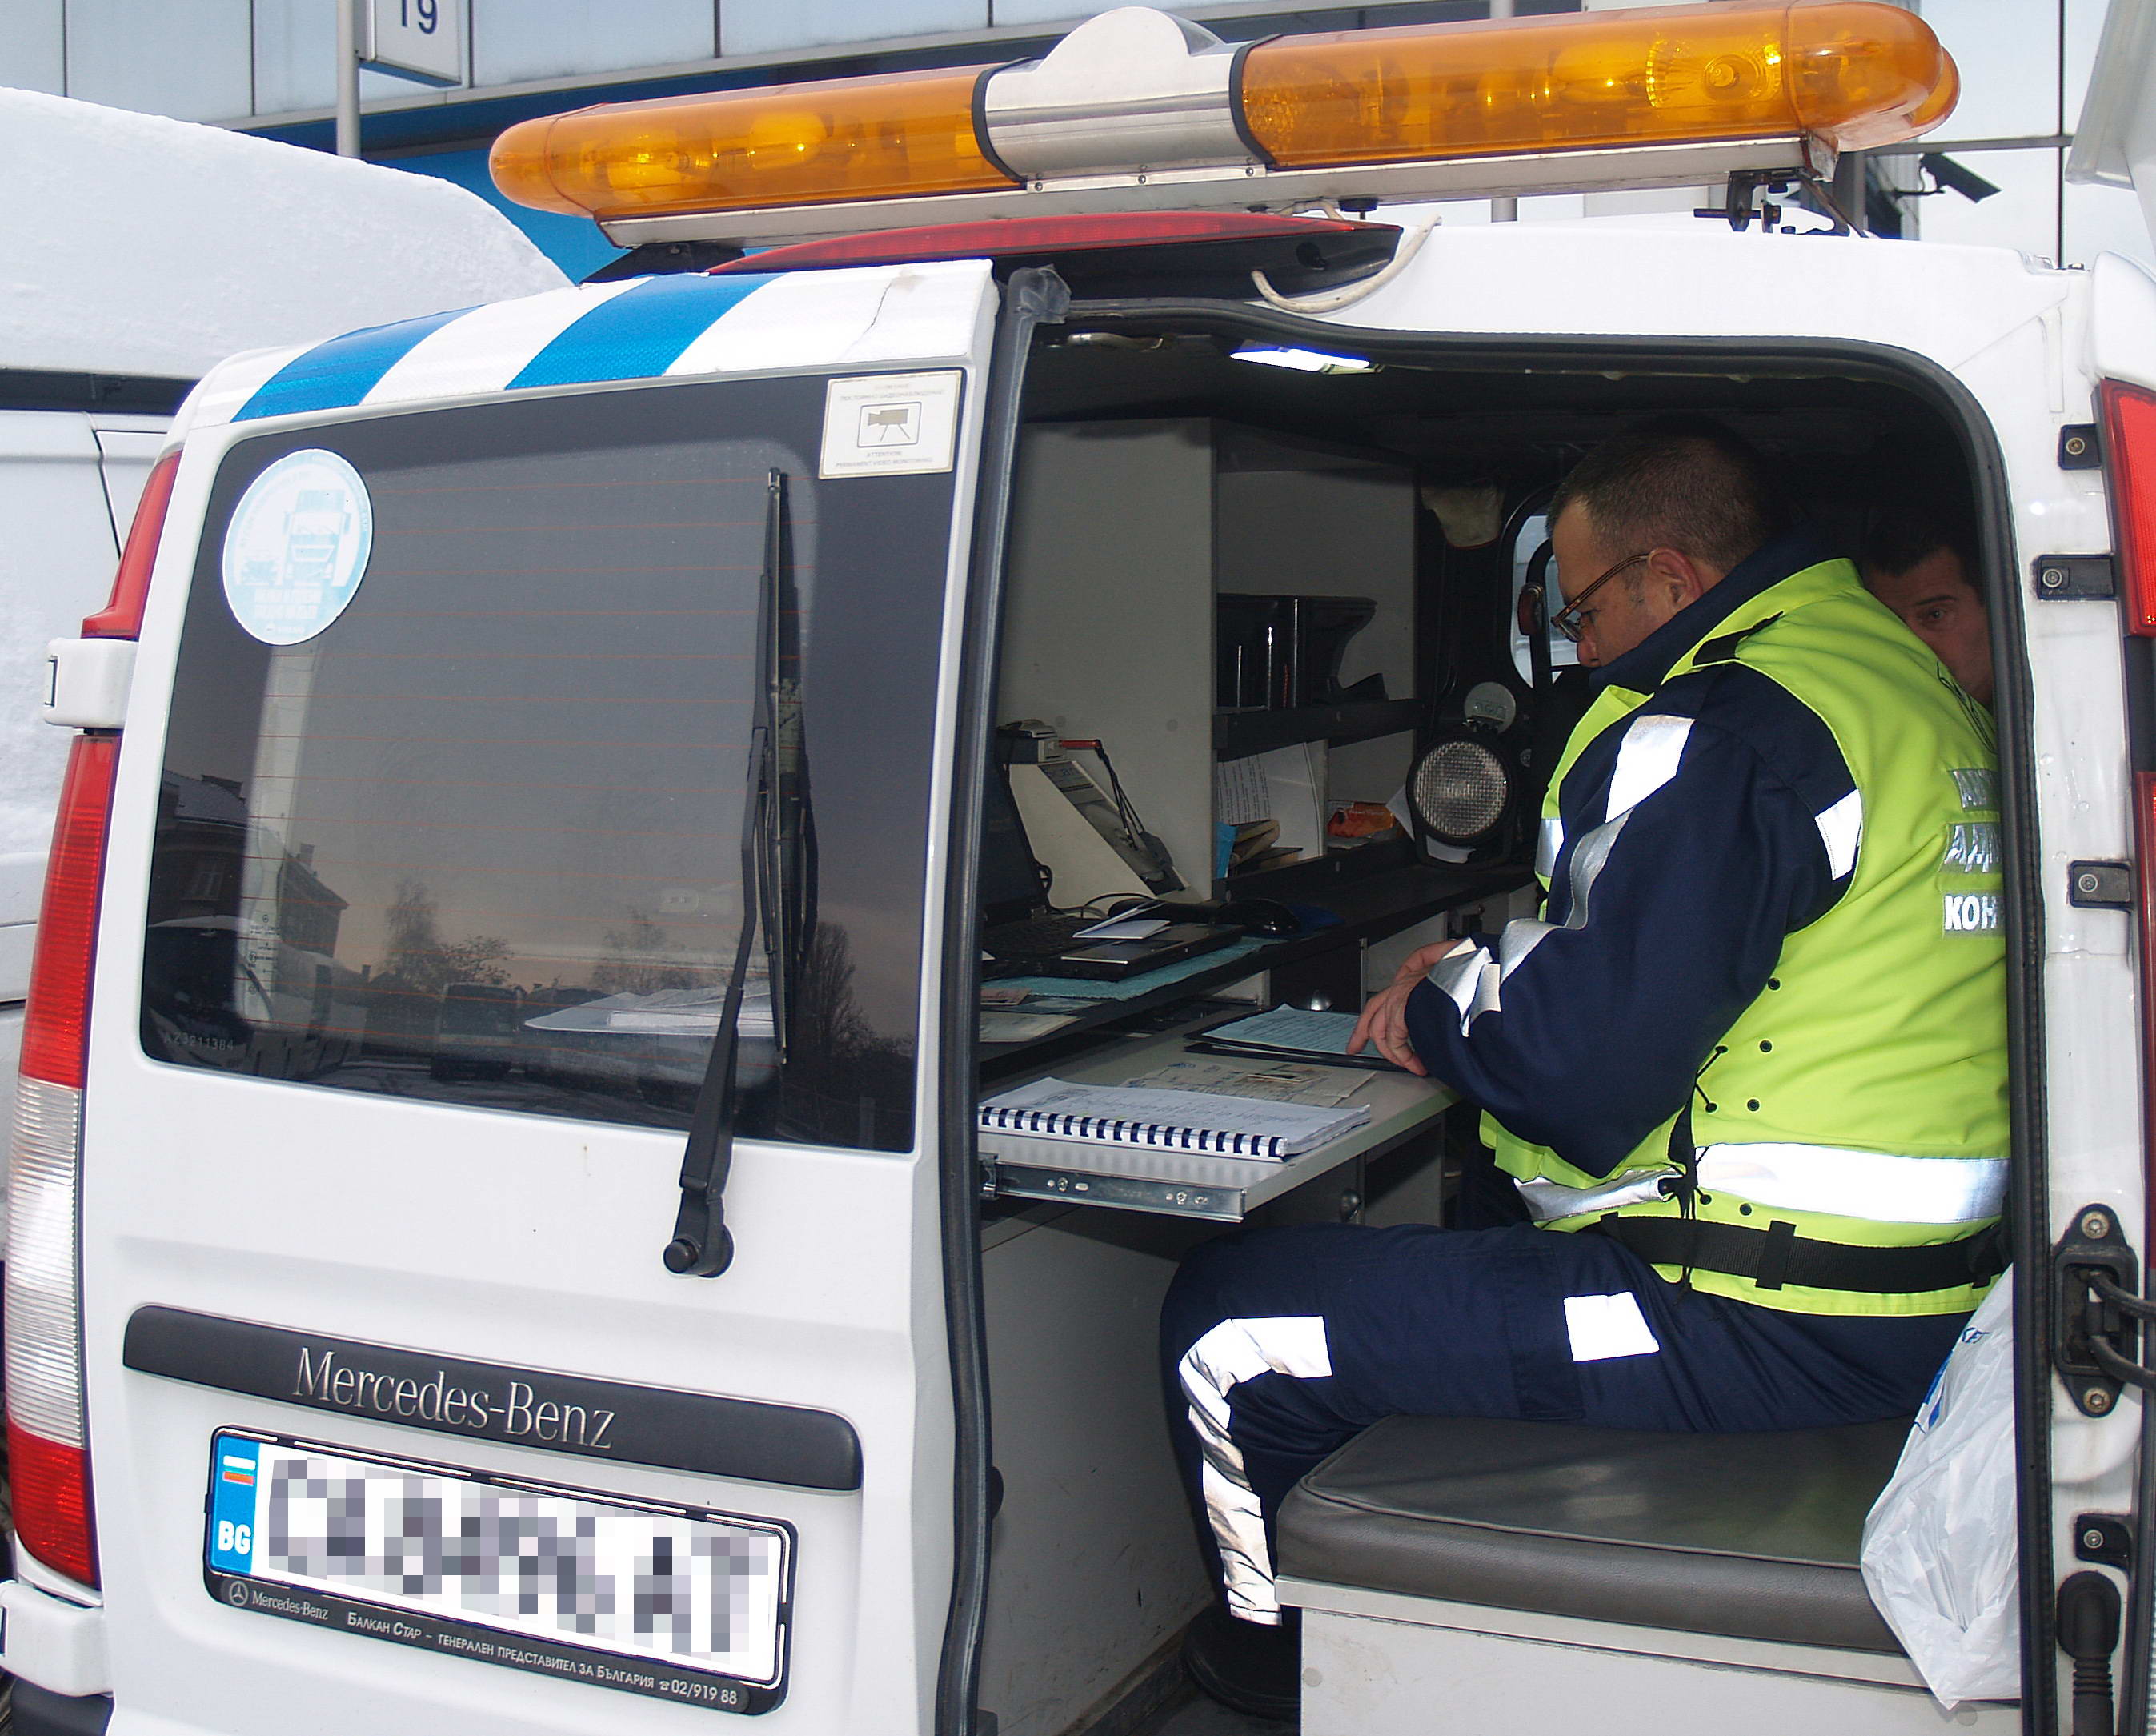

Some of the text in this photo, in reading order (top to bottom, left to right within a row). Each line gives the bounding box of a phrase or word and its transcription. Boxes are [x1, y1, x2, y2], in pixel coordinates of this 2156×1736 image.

[1945, 895, 2002, 932] КОН
[292, 1347, 615, 1449] Mercedes-Benz
[218, 1520, 251, 1555] BG
[251, 1590, 329, 1620] Mercedes-Benz
[438, 1634, 494, 1657] ГЕНЕРАЛЕН
[497, 1646, 576, 1673] ПРЕДСТАВИТЕЛ
[579, 1663, 594, 1677] ЗА
[597, 1665, 655, 1689] БЪЛГАРИЯ
[721, 1689, 738, 1705] 88
